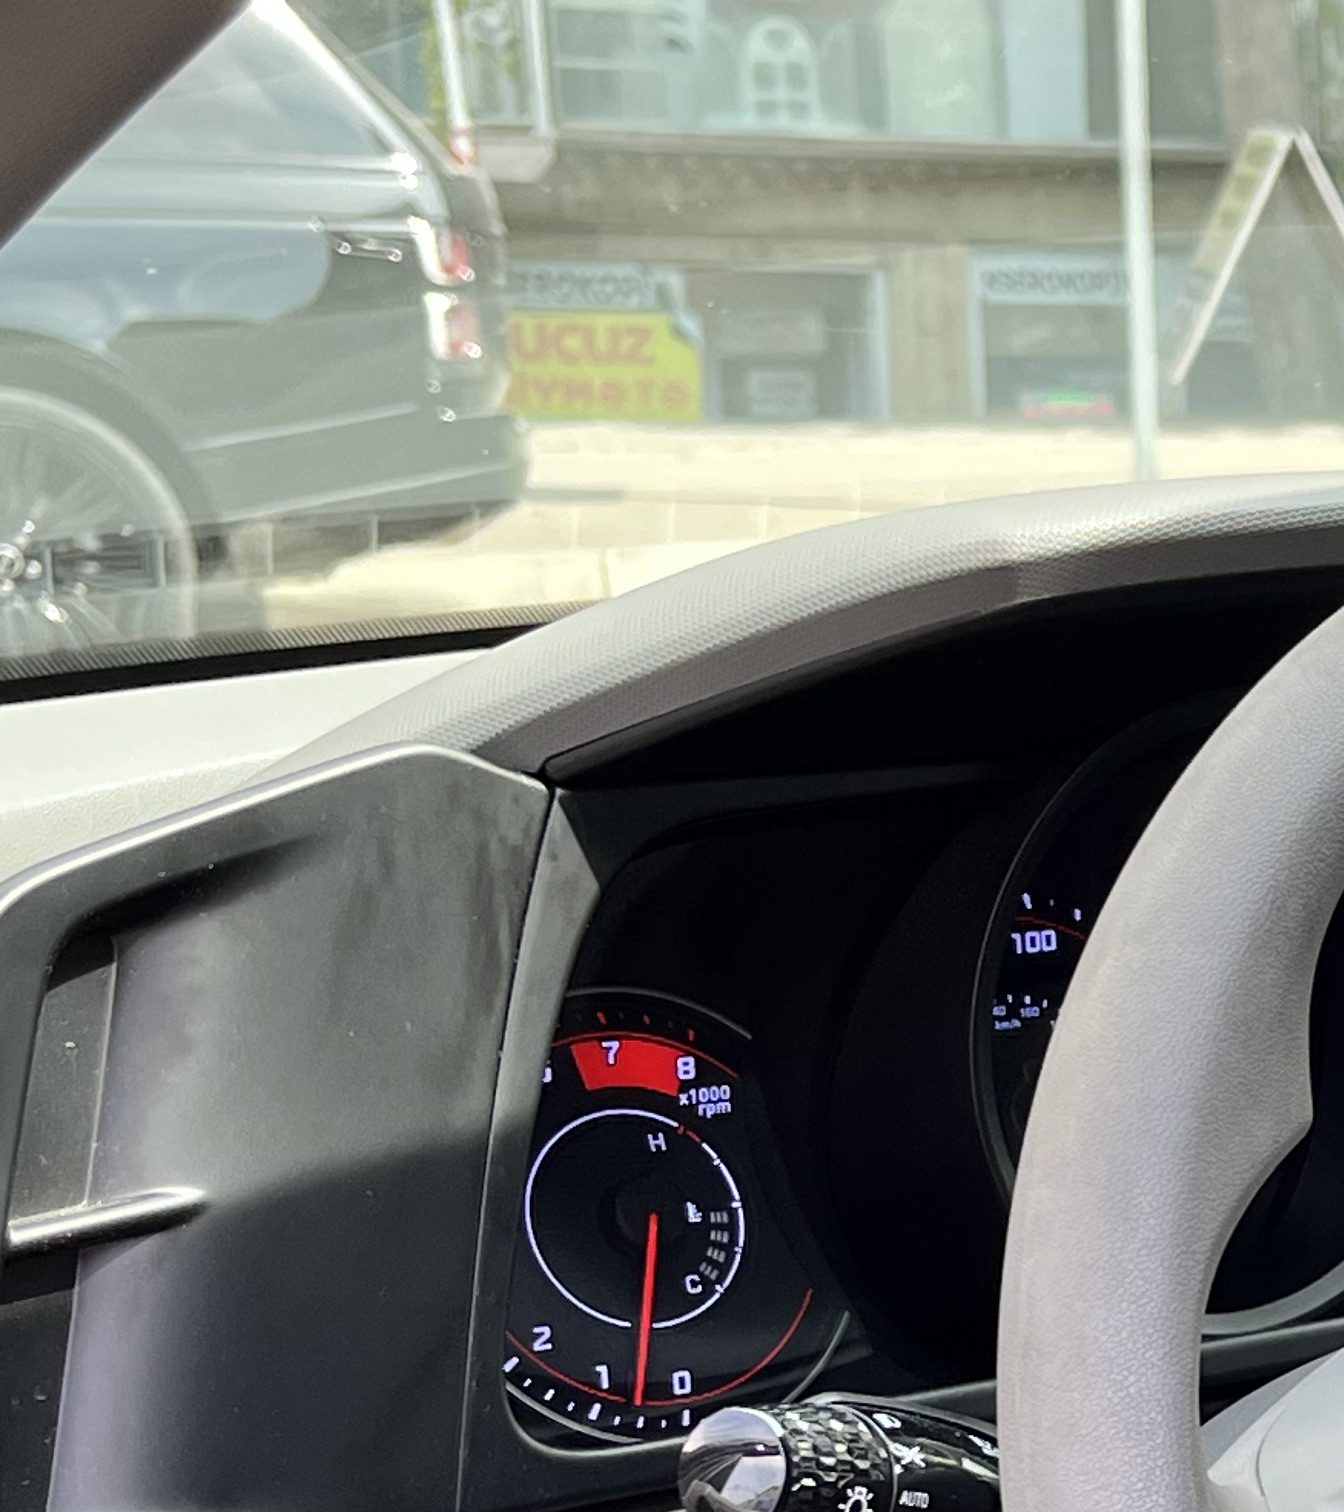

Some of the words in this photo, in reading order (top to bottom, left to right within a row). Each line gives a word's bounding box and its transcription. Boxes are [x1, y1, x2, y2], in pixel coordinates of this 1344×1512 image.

[505, 319, 656, 367] UCUZ
[1010, 929, 1057, 954] 100
[601, 1040, 620, 1065] 7
[676, 1055, 696, 1080] 8
[678, 1084, 731, 1106] x1000
[697, 1100, 732, 1119] rpm
[647, 1132, 668, 1152] H
[684, 1273, 703, 1295] C
[531, 1326, 553, 1351] 2
[594, 1365, 610, 1390] 1
[672, 1370, 692, 1395] 0
[899, 1490, 930, 1509] AUTO
